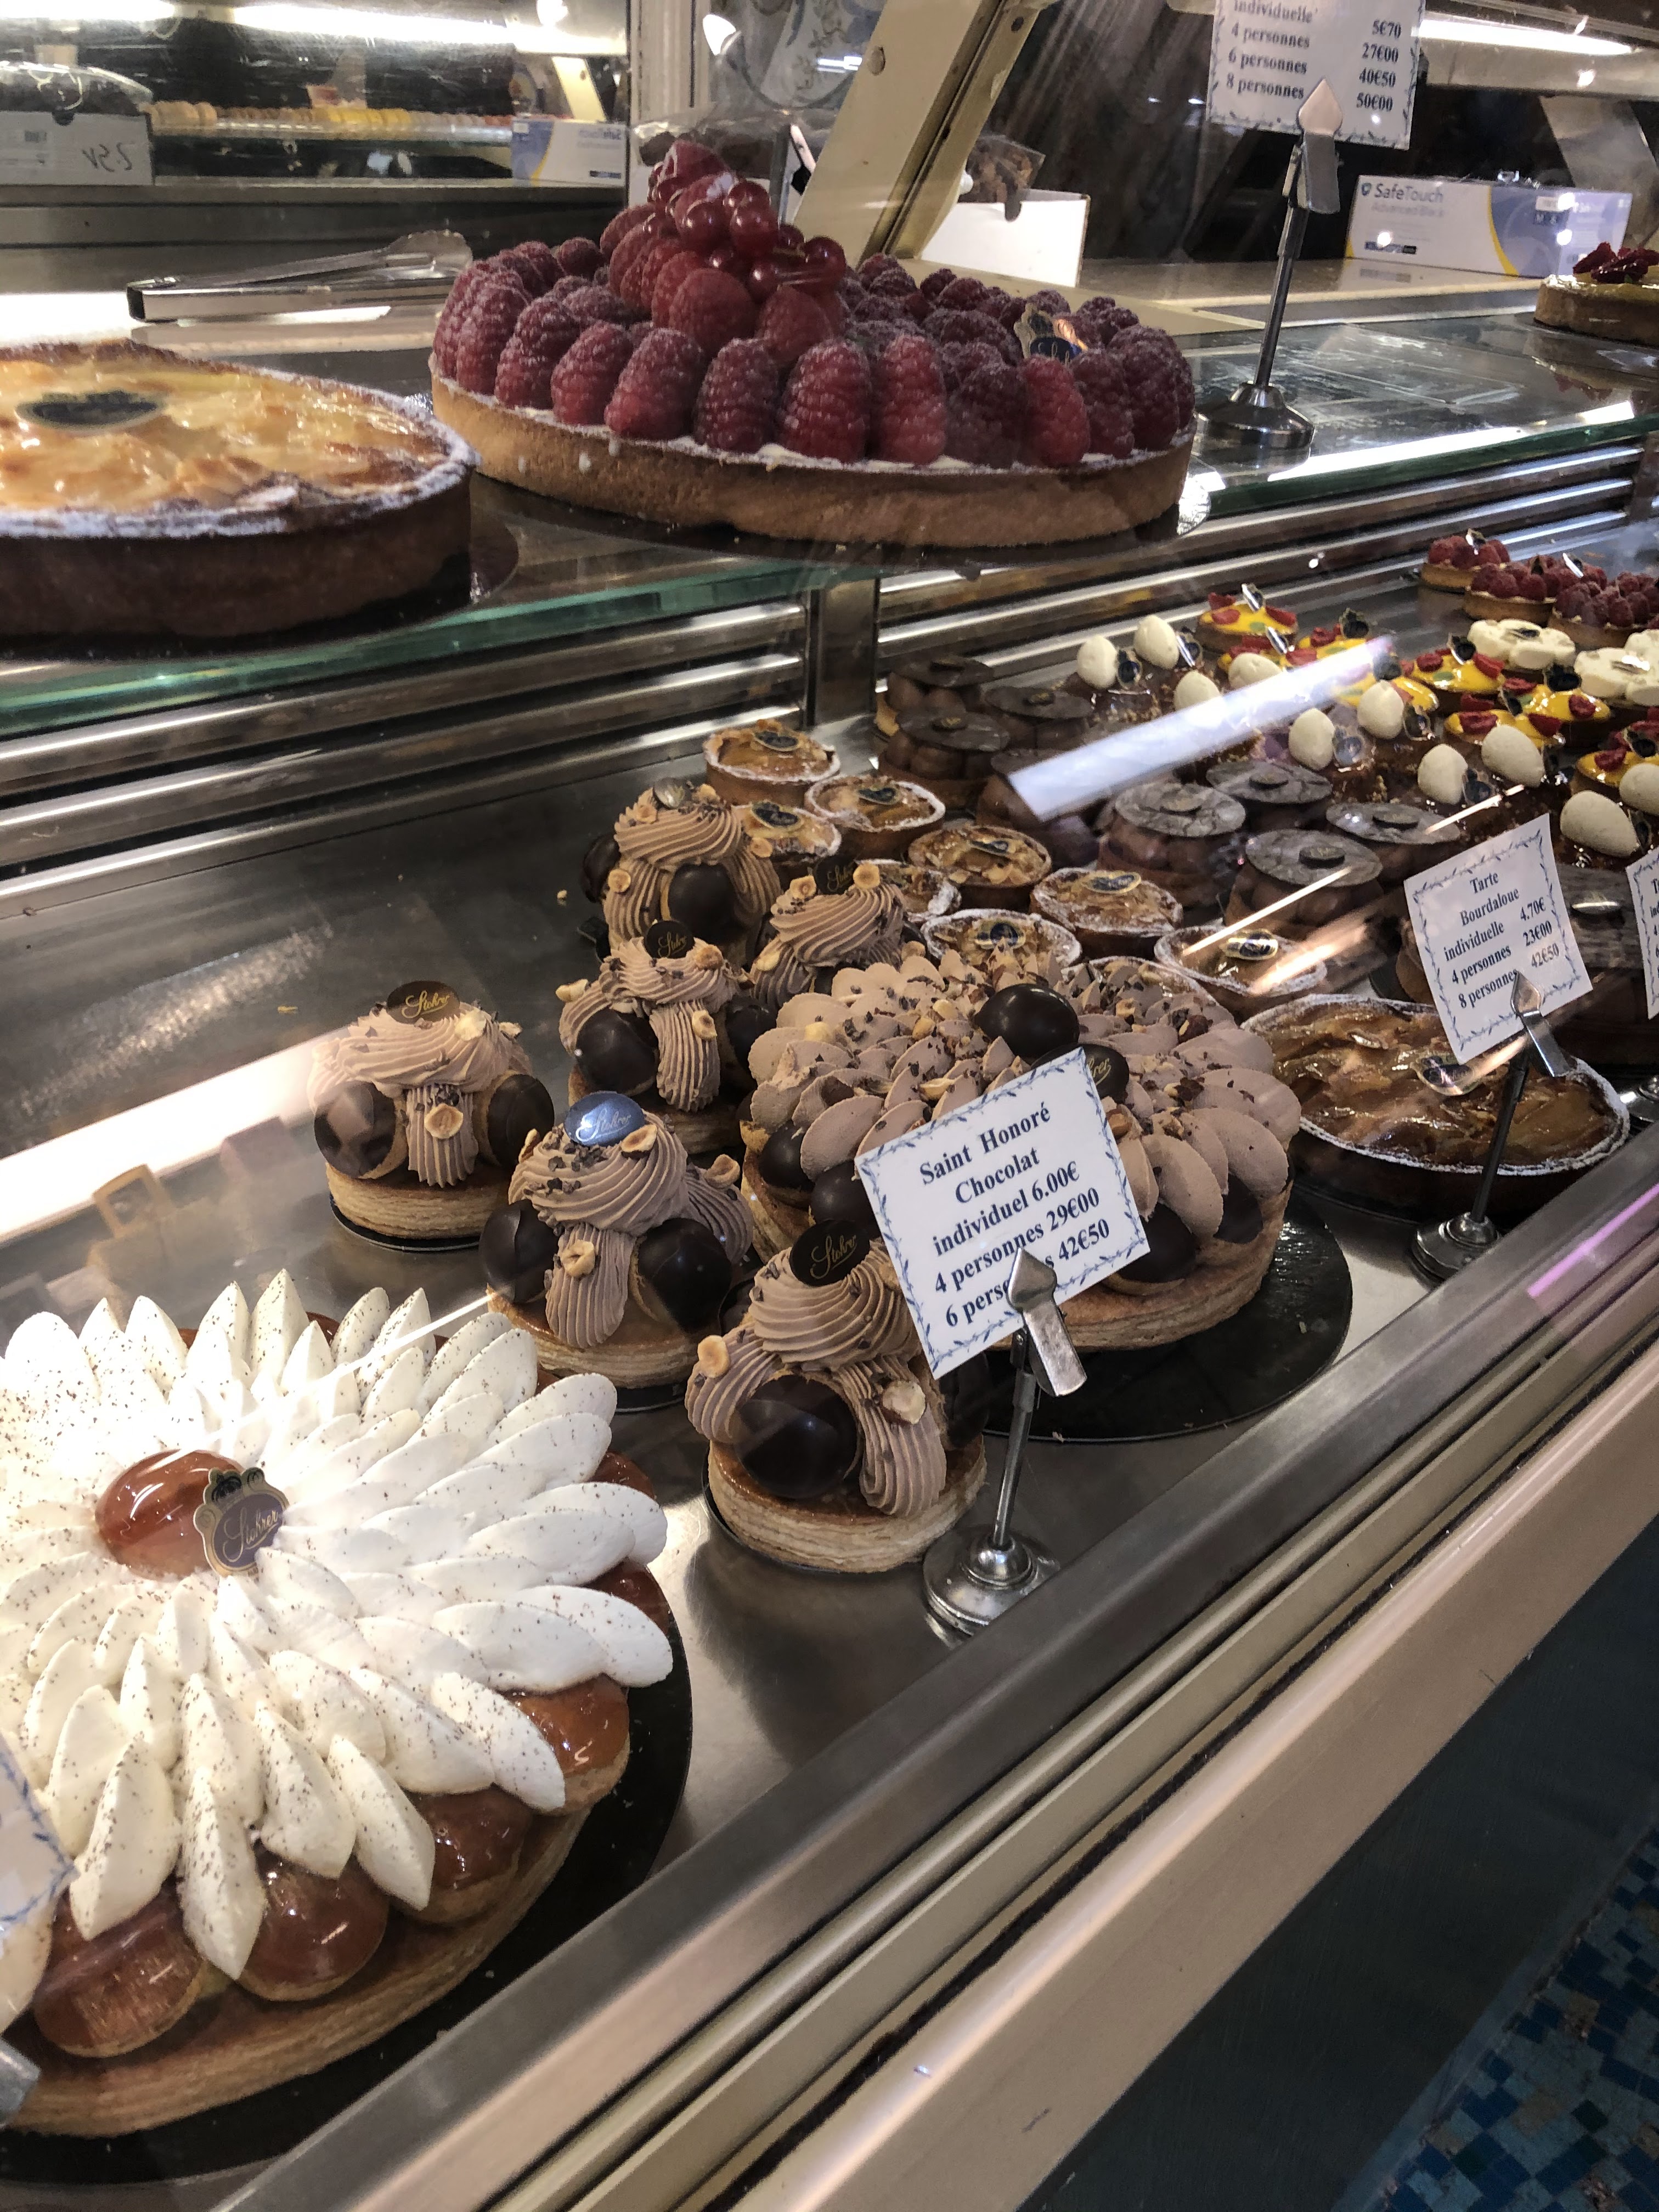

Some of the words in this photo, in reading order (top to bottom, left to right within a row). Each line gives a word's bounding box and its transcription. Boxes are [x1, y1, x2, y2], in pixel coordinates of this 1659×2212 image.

[1231, 22, 1239, 37] 4
[1243, 27, 1310, 49] personnes
[1362, 42, 1400, 64] 27€00
[1234, 0, 1312, 24] individuelle
[1372, 19, 1402, 39] 5€70
[1226, 72, 1235, 89] 8
[1237, 78, 1305, 99] personnes
[1356, 92, 1393, 111] 50€00
[1228, 47, 1237, 63] 6
[1240, 53, 1307, 75] personnes
[1359, 67, 1397, 88] 40€50
[1374, 183, 1443, 202] SafeTouch
[1459, 888, 1520, 927] Bourdaloue
[1469, 872, 1499, 894] Tarte
[1443, 921, 1505, 961] individuelle
[1520, 896, 1547, 922] 4.70€
[1452, 969, 1459, 985] 4
[1460, 945, 1512, 985] personnes
[1522, 919, 1553, 947] 23€00
[1458, 993, 1467, 1009] 8
[1531, 942, 1560, 968] 42€50
[919, 1144, 973, 1186] Saint
[979, 1101, 1051, 1154] Honoré
[955, 1147, 1040, 1204] Chocolat
[932, 1188, 1029, 1257] individuel
[1031, 1160, 1080, 1202] 6.00€
[935, 1271, 947, 1294] 4
[951, 1222, 1045, 1292] personnes
[1046, 1187, 1100, 1233] 29€00
[946, 1304, 958, 1328] 6
[1058, 1218, 1110, 1261] 42€50
